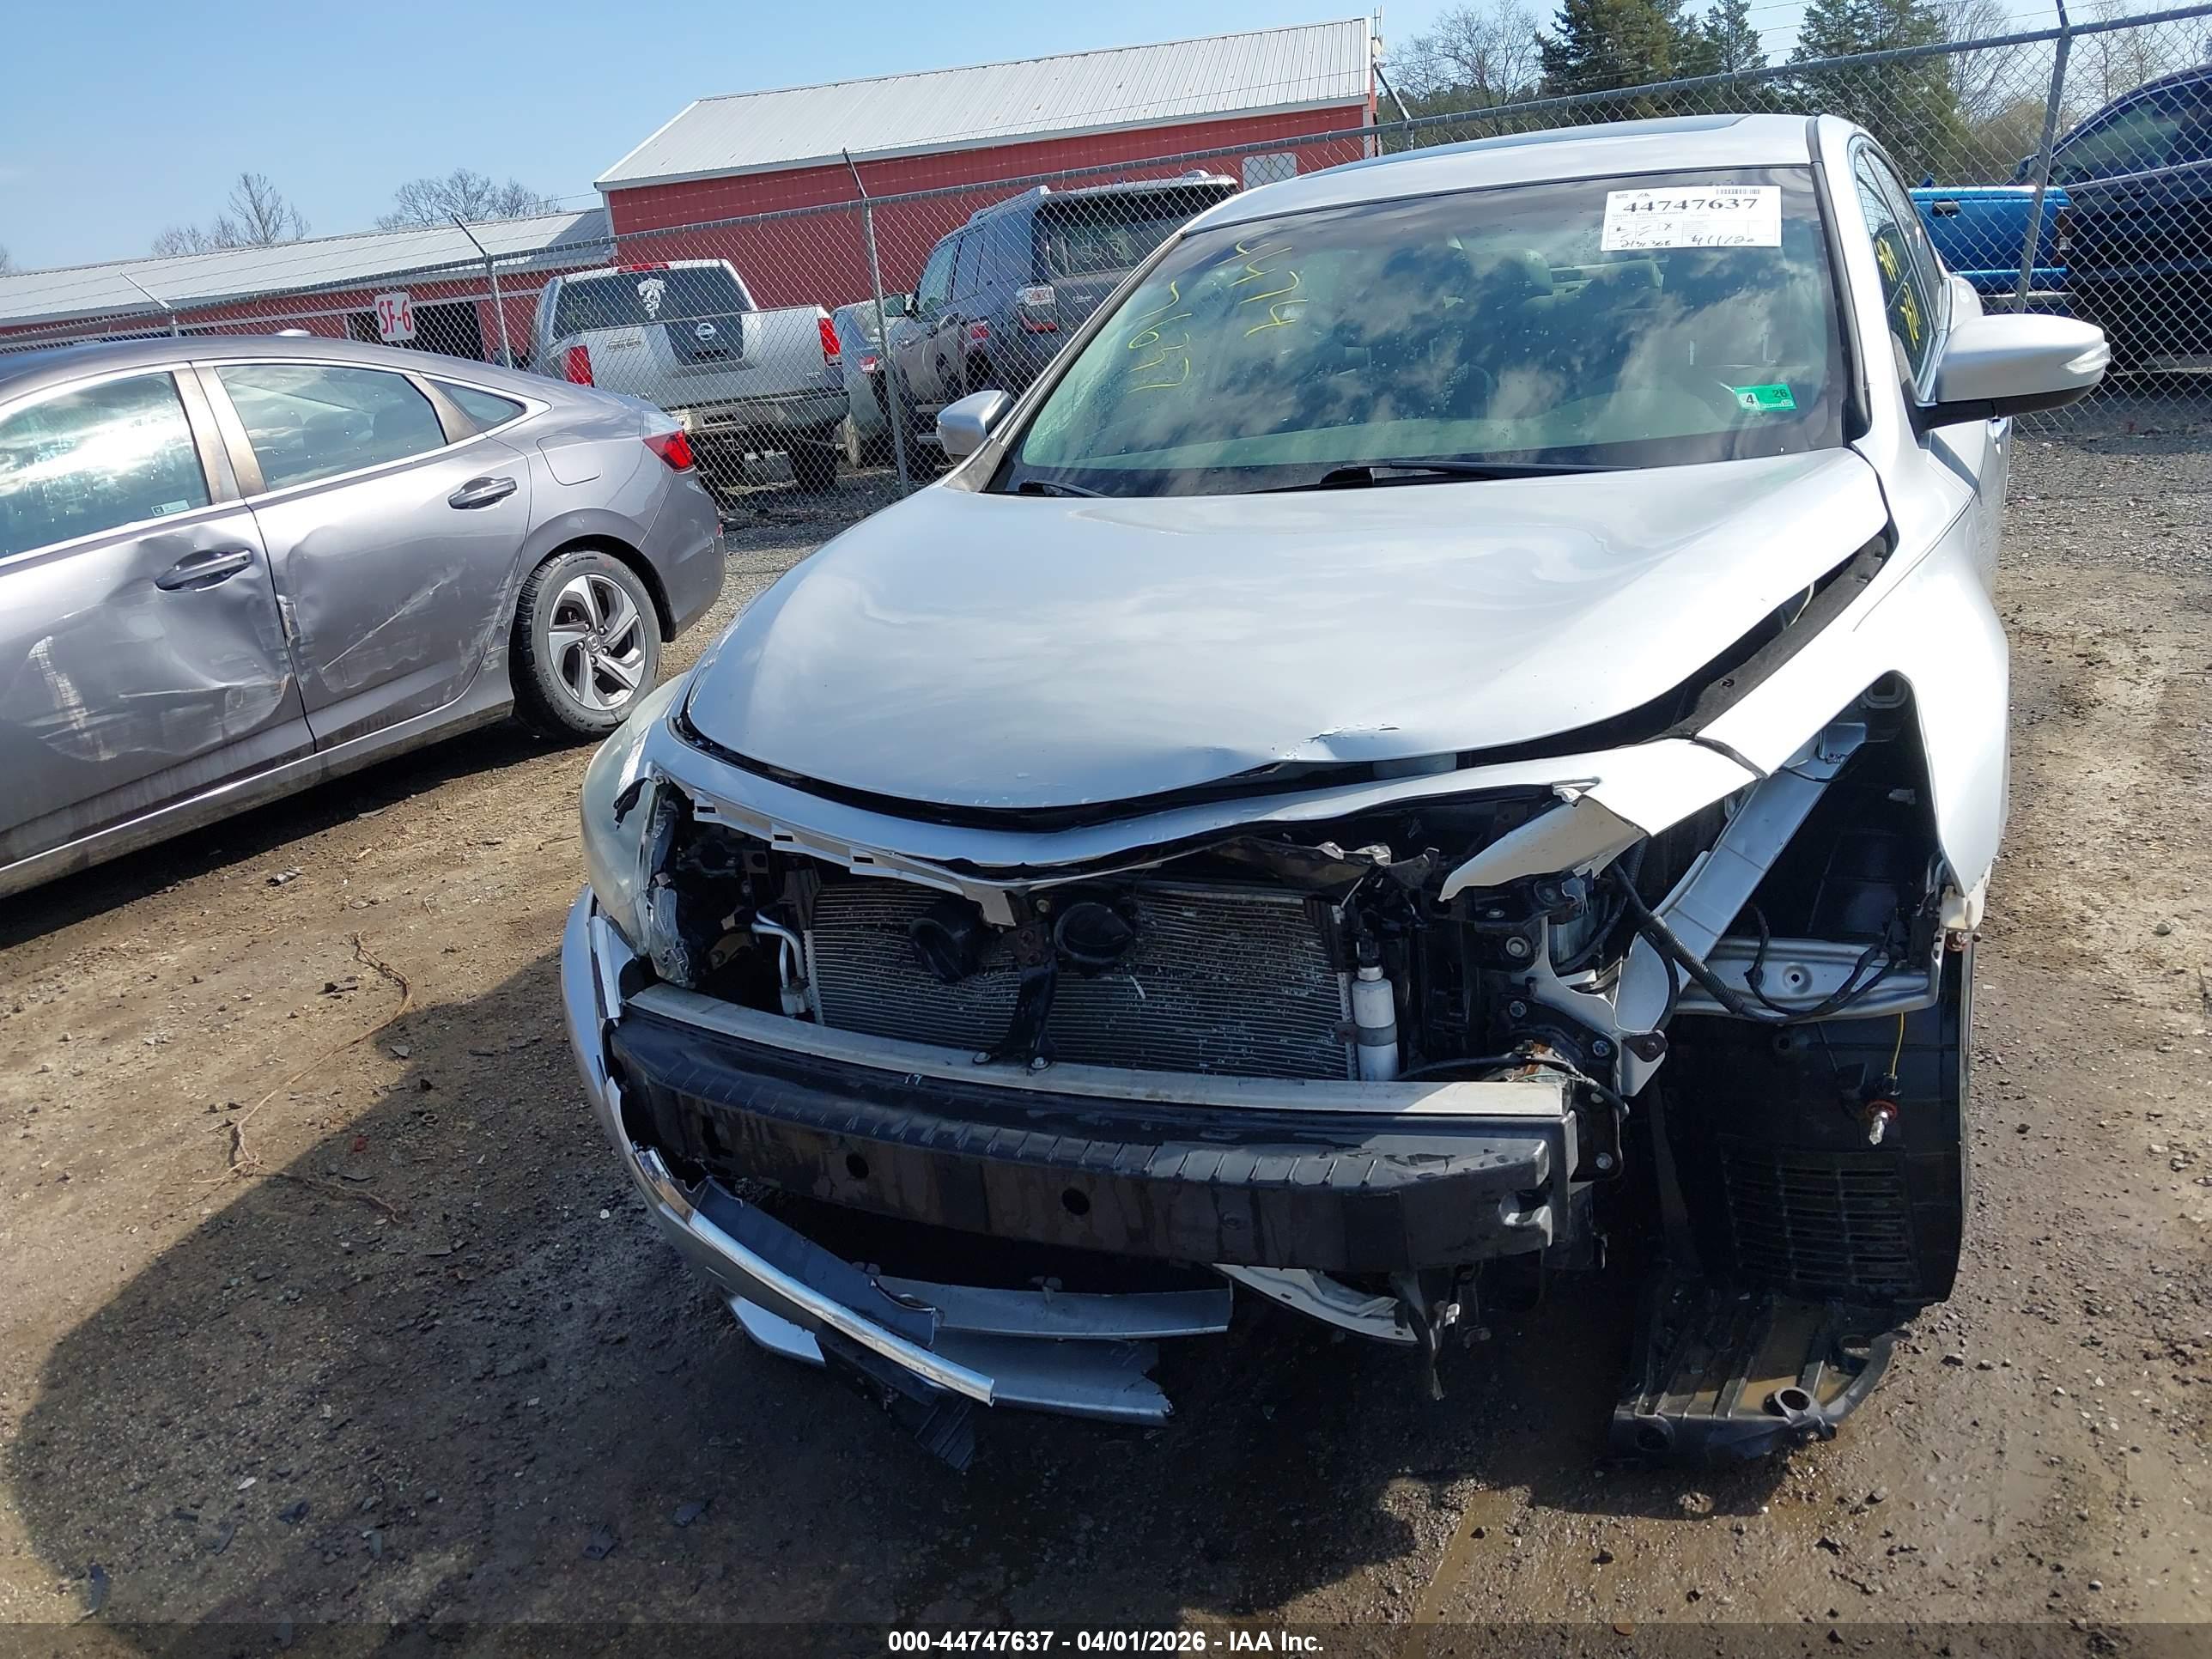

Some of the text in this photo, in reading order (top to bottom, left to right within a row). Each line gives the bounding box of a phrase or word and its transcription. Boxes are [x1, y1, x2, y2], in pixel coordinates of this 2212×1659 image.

[1623, 198, 1759, 213] 44747637
[378, 300, 412, 335] SF-6
[1746, 394, 1754, 404] 4
[1772, 389, 1788, 398] 26
